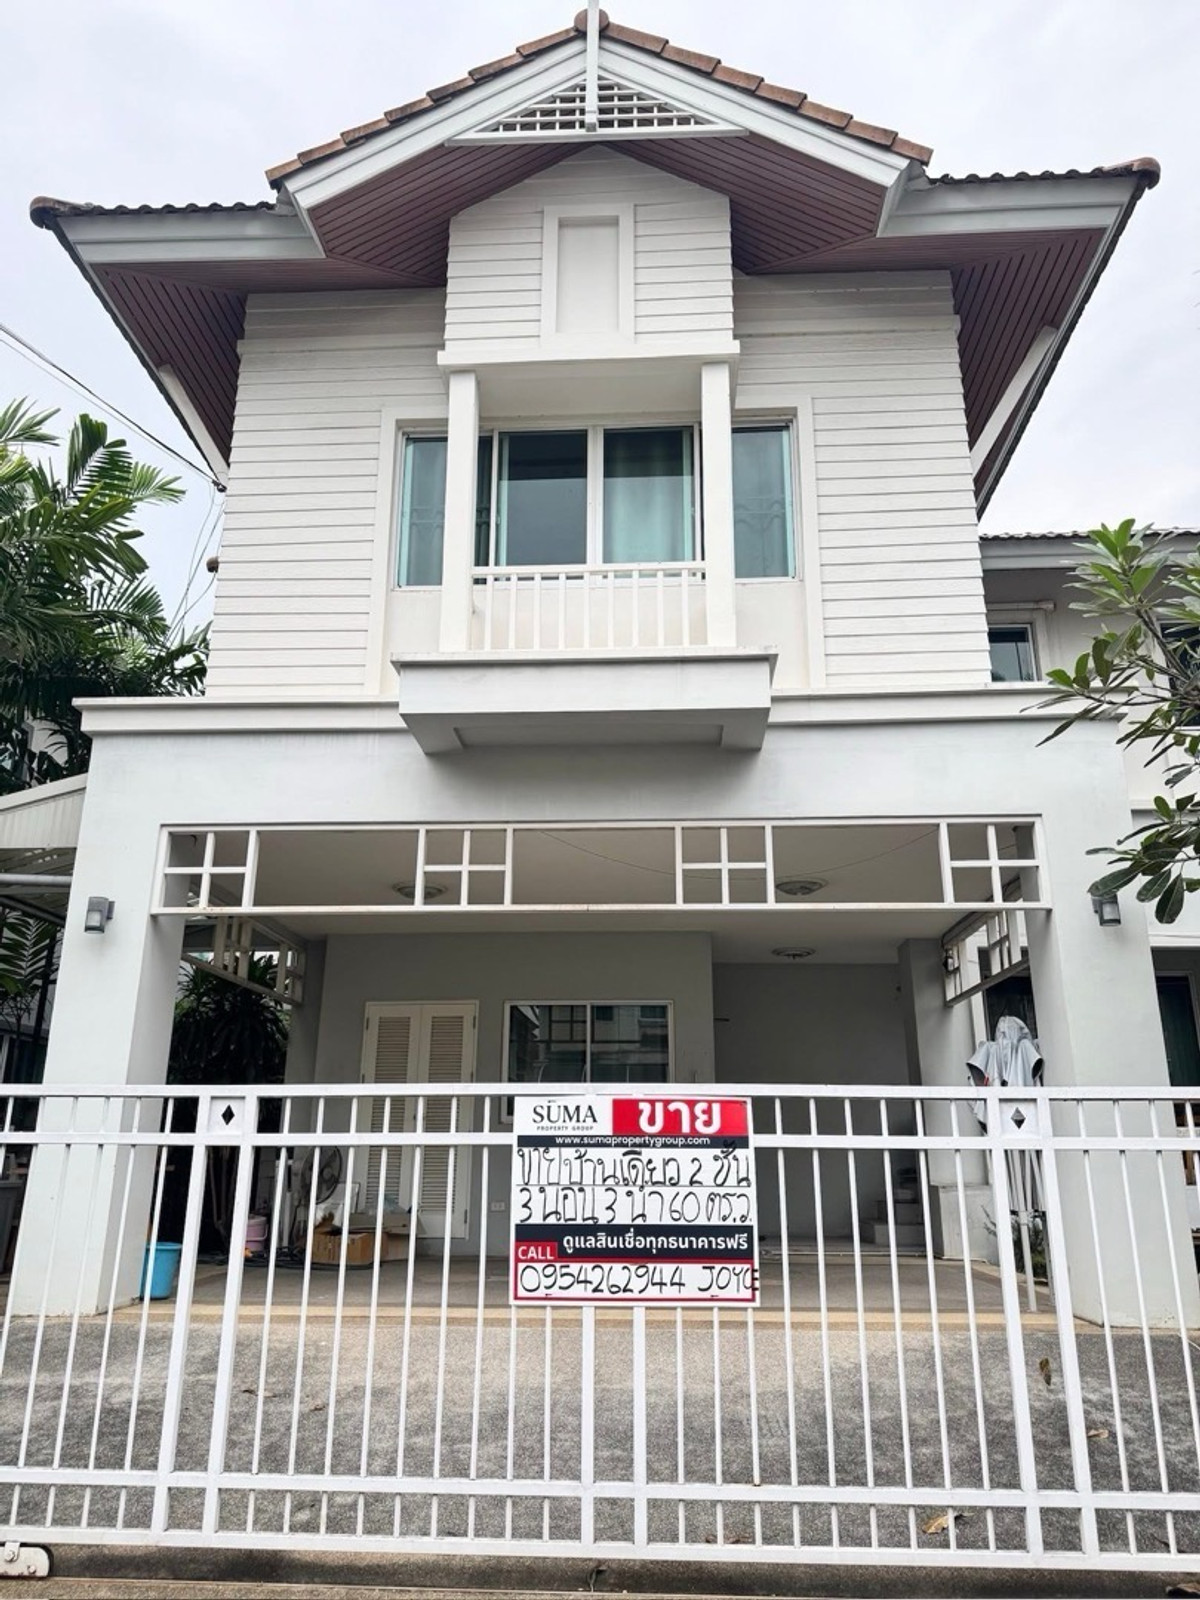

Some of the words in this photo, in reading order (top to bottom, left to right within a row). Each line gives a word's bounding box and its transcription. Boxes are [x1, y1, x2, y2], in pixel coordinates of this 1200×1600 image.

[638, 1101, 721, 1135] ขาย
[555, 1135, 711, 1148] www.sumapropertygroup.com
[688, 1157, 704, 1187] 2
[519, 1186, 533, 1224] 3
[538, 1186, 600, 1225] นอน
[604, 1186, 618, 1224] 3
[668, 1191, 700, 1223] 60
[517, 1245, 555, 1260] CALL
[562, 1227, 749, 1255] ดูแลสินเชื่อทุกธนาคารฟรี
[520, 1263, 686, 1295] 0954262944
